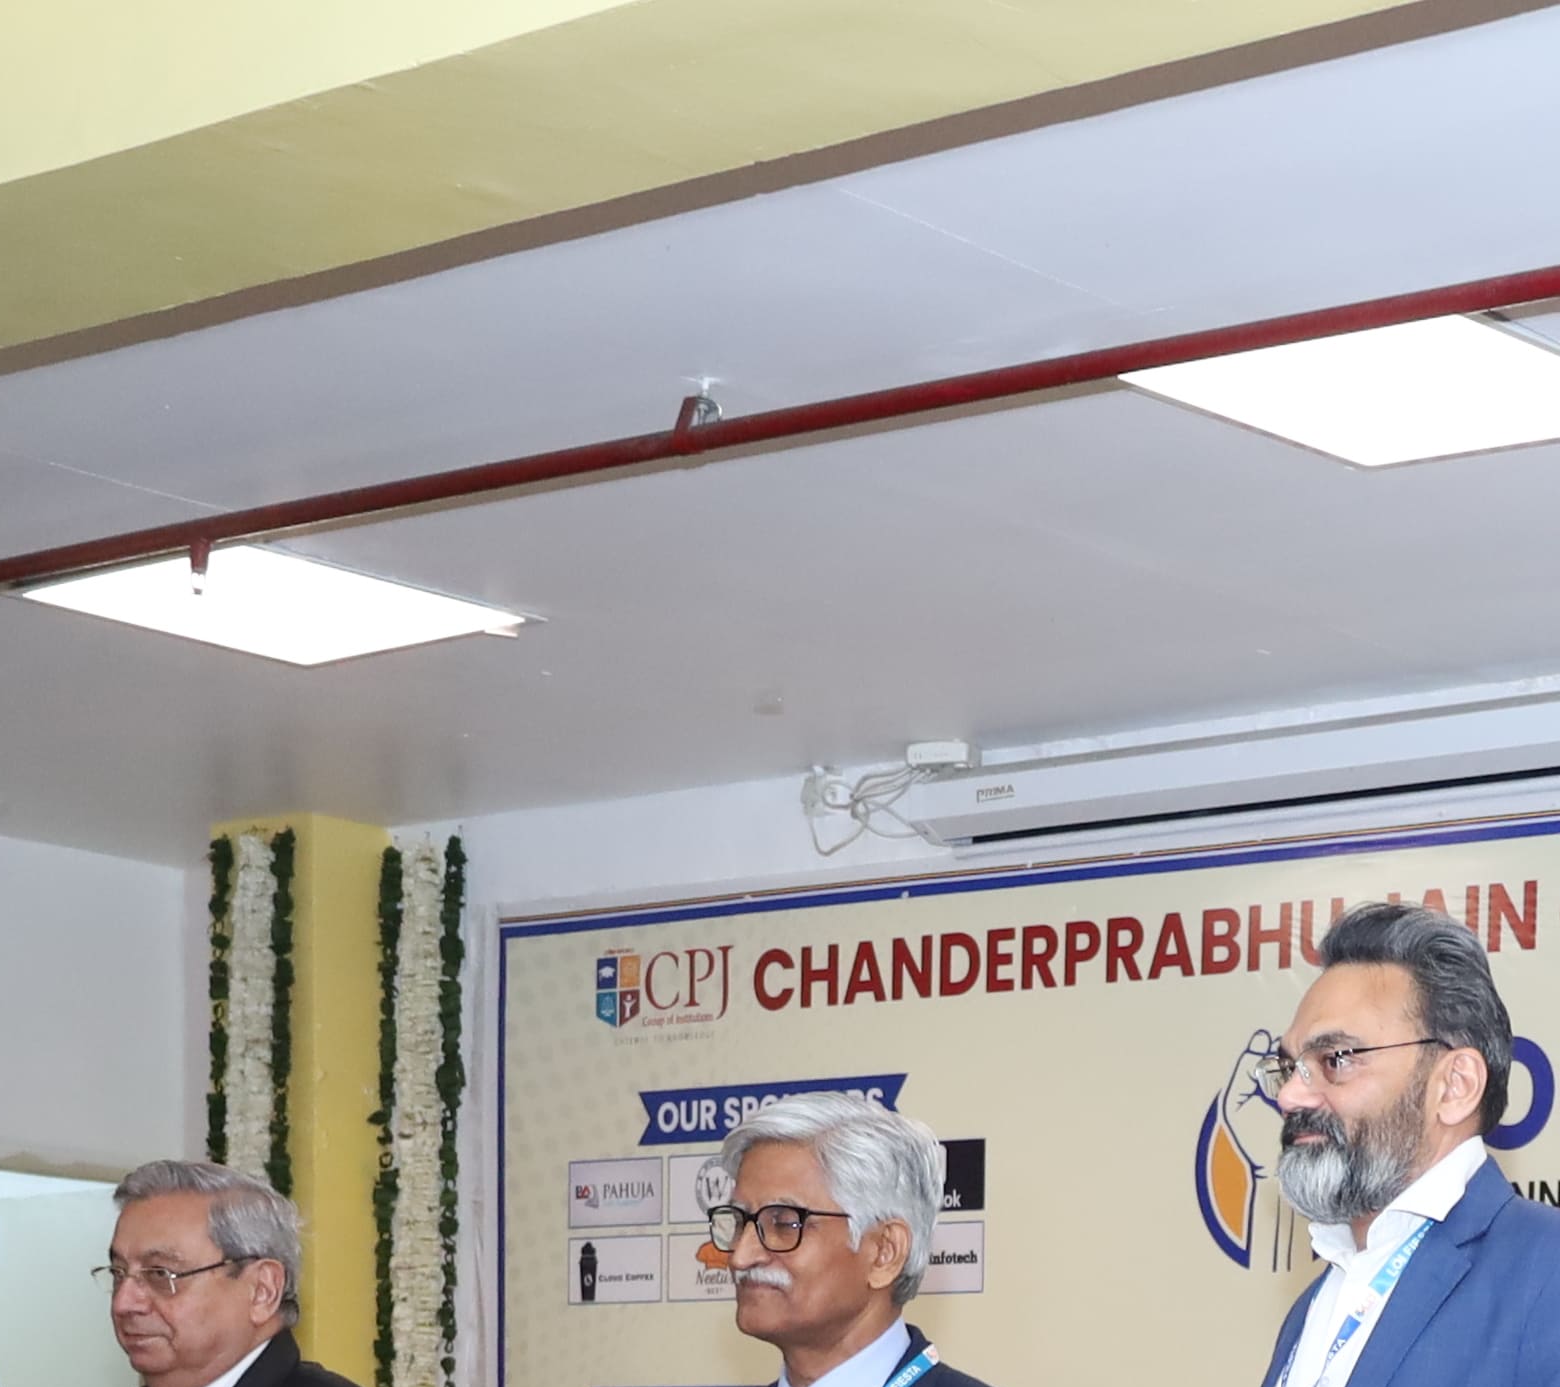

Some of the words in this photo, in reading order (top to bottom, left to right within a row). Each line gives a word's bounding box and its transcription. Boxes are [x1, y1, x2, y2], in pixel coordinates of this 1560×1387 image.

[1387, 880, 1538, 953] IN
[644, 944, 735, 1020] CPJ
[656, 1098, 719, 1134] OUR
[602, 1181, 655, 1200] PAHUJA
